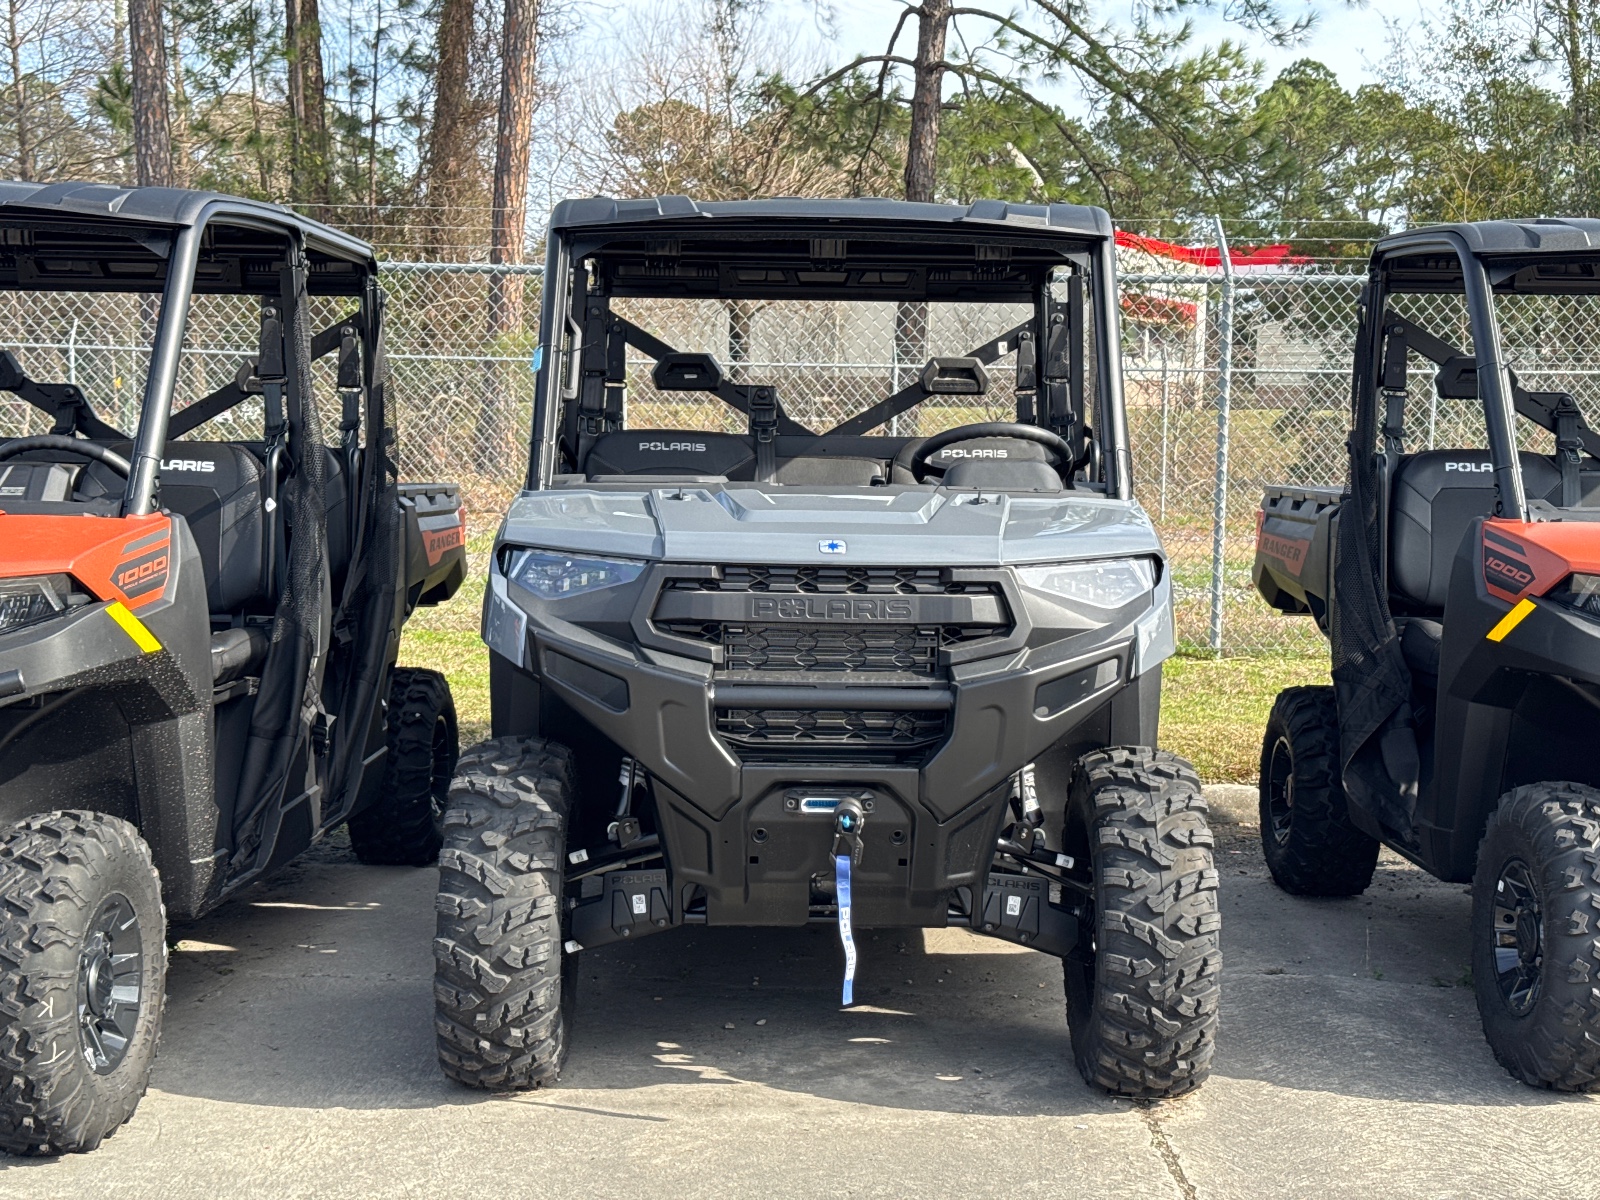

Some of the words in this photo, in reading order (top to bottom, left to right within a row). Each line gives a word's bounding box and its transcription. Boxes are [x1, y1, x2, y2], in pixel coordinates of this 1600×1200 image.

[638, 442, 707, 452] POLARIS
[941, 449, 1008, 459] POLARIS
[160, 459, 215, 472] LARIS
[429, 531, 461, 552] RANGER
[1262, 537, 1302, 562] RANGER
[118, 555, 167, 587] 1000
[1485, 556, 1532, 584] 1000
[752, 598, 912, 620] POLARIS
[611, 874, 665, 885] POLAR
[840, 907, 857, 981] POLARIS
[141, 952, 160, 1051] CARLSTAR
